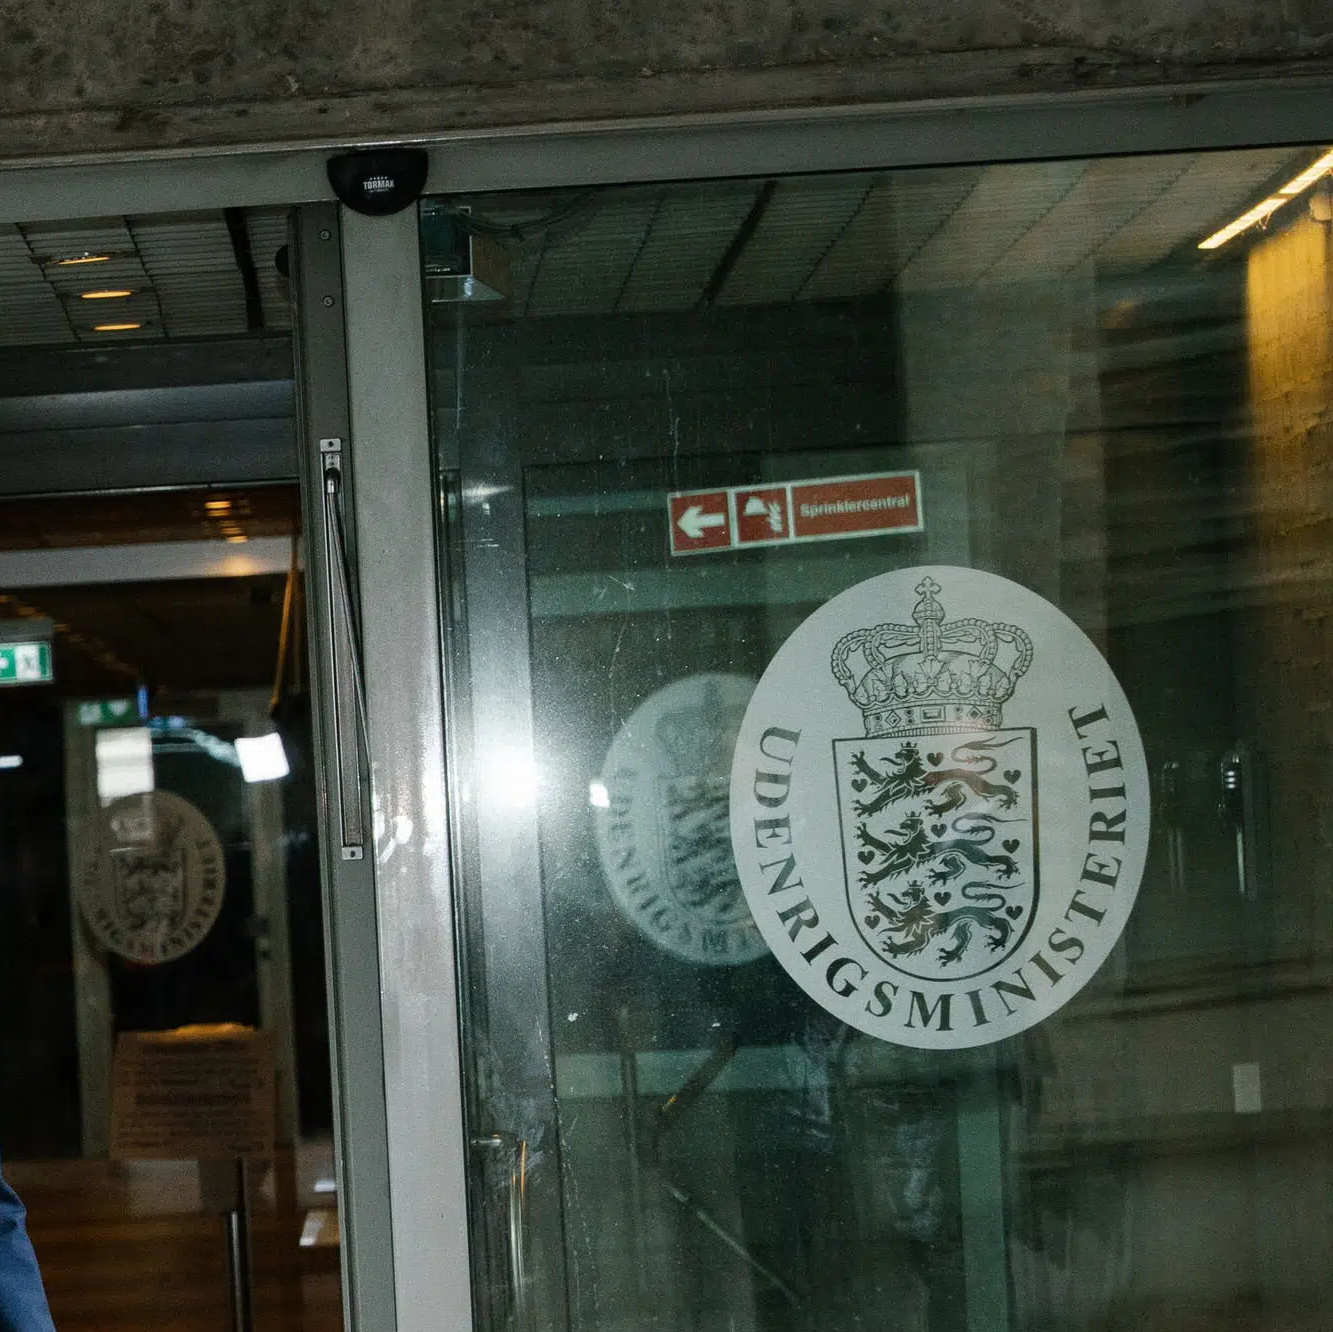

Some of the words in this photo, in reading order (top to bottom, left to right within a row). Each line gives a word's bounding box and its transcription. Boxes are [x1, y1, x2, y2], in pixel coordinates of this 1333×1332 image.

[362, 179, 395, 190] TORMAX
[799, 493, 911, 519] Sprinklercentral
[753, 701, 1128, 1033] UDENRIGSMINISTERIET
